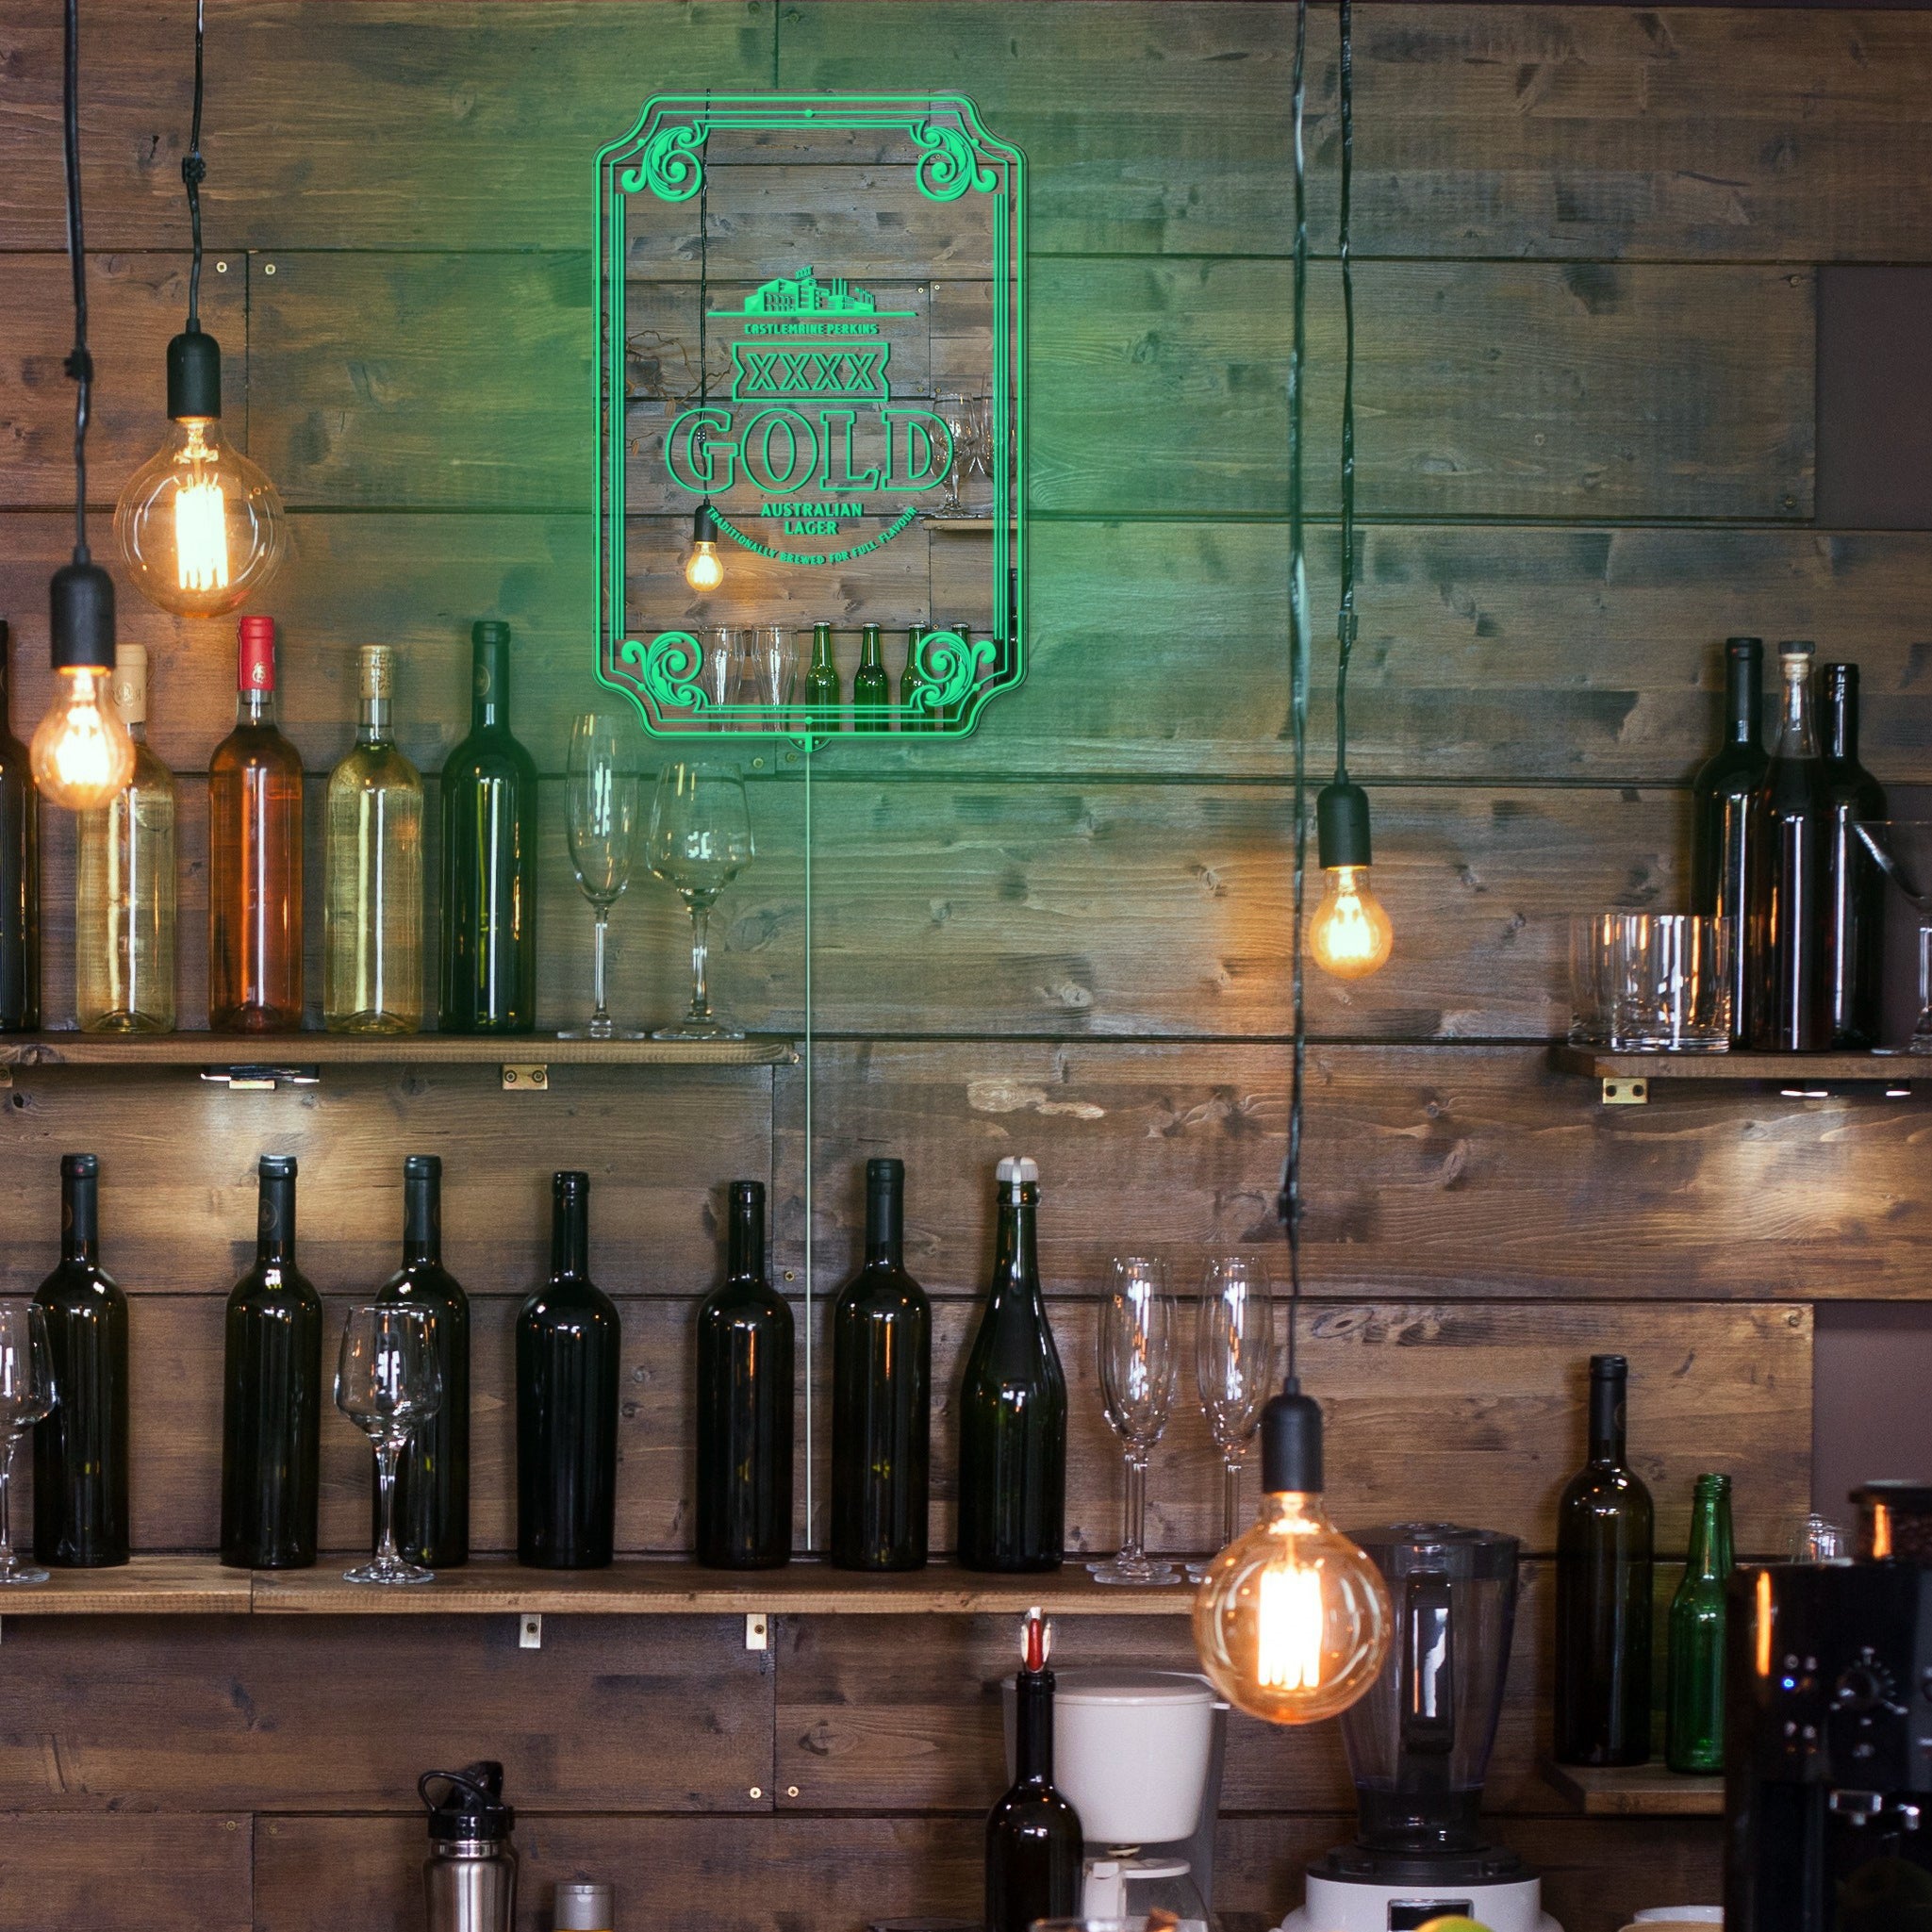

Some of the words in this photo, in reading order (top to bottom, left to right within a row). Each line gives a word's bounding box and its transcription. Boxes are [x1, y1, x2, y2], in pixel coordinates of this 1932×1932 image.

[744, 323, 824, 335] CASTLEMAINE
[827, 323, 879, 335] PERKINS
[746, 354, 878, 391] XXXX
[665, 407, 954, 494] GOLD
[761, 503, 864, 518] AUSTRALIAN
[706, 505, 778, 559] TRADITIONALLY
[779, 552, 825, 565] BREWED
[829, 551, 851, 564] FOR
[851, 540, 880, 558] FULL
[878, 506, 919, 544] FLAVOUR
[784, 520, 838, 535] LAGER
